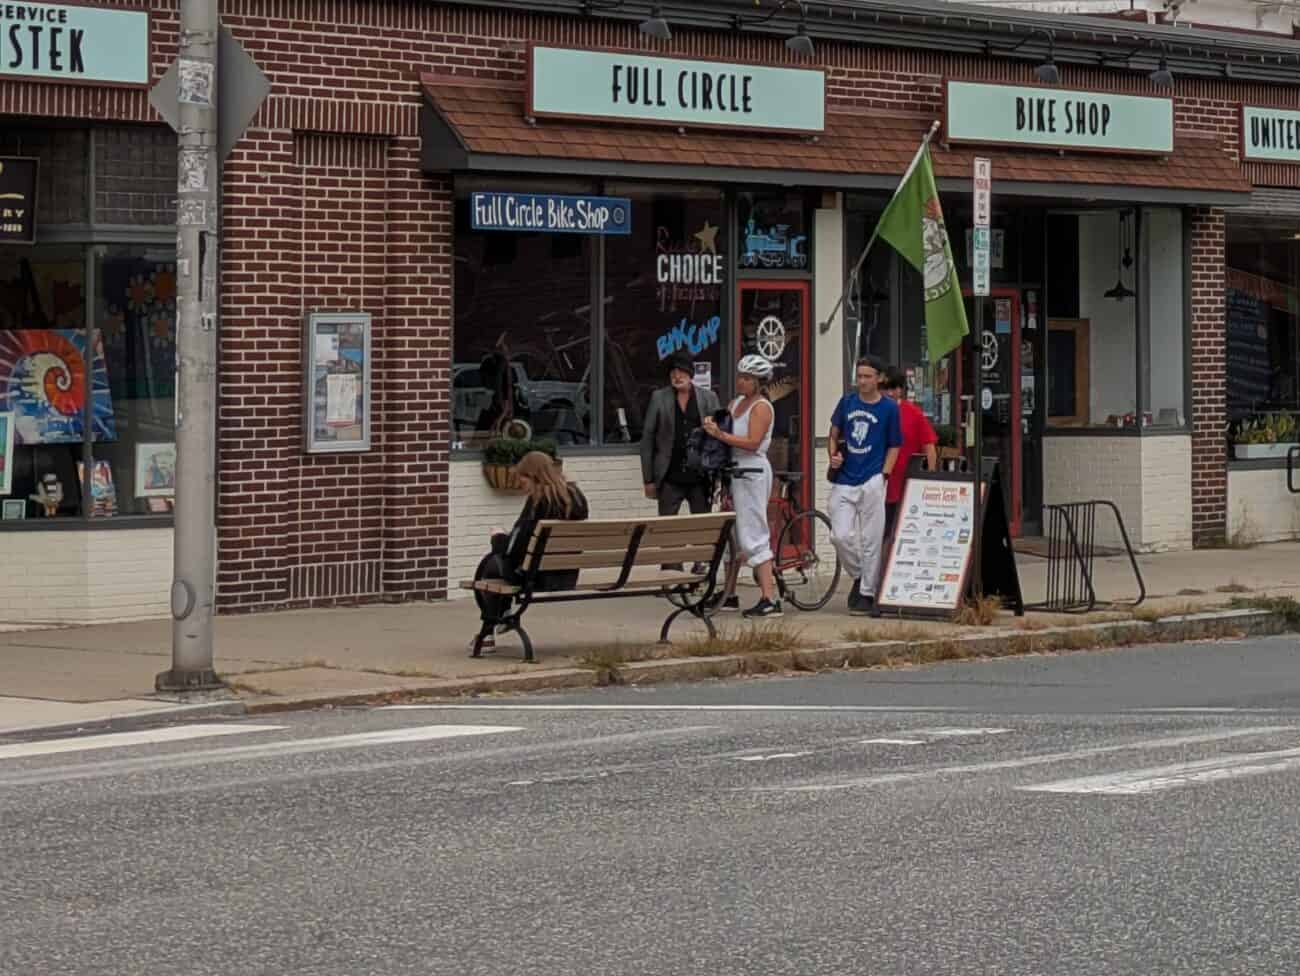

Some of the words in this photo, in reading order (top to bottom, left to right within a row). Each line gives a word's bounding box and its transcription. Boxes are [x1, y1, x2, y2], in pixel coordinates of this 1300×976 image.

[0, 24, 84, 72] STEK
[612, 65, 666, 107] FULL
[678, 70, 752, 112] CIRCLE
[1015, 96, 1056, 133] BIKE
[1065, 100, 1110, 136] SHOP
[475, 195, 501, 225] Full
[505, 197, 544, 227] Circle
[548, 200, 576, 229] Bike
[577, 200, 609, 230] Shop
[656, 254, 724, 284] CHOICE
